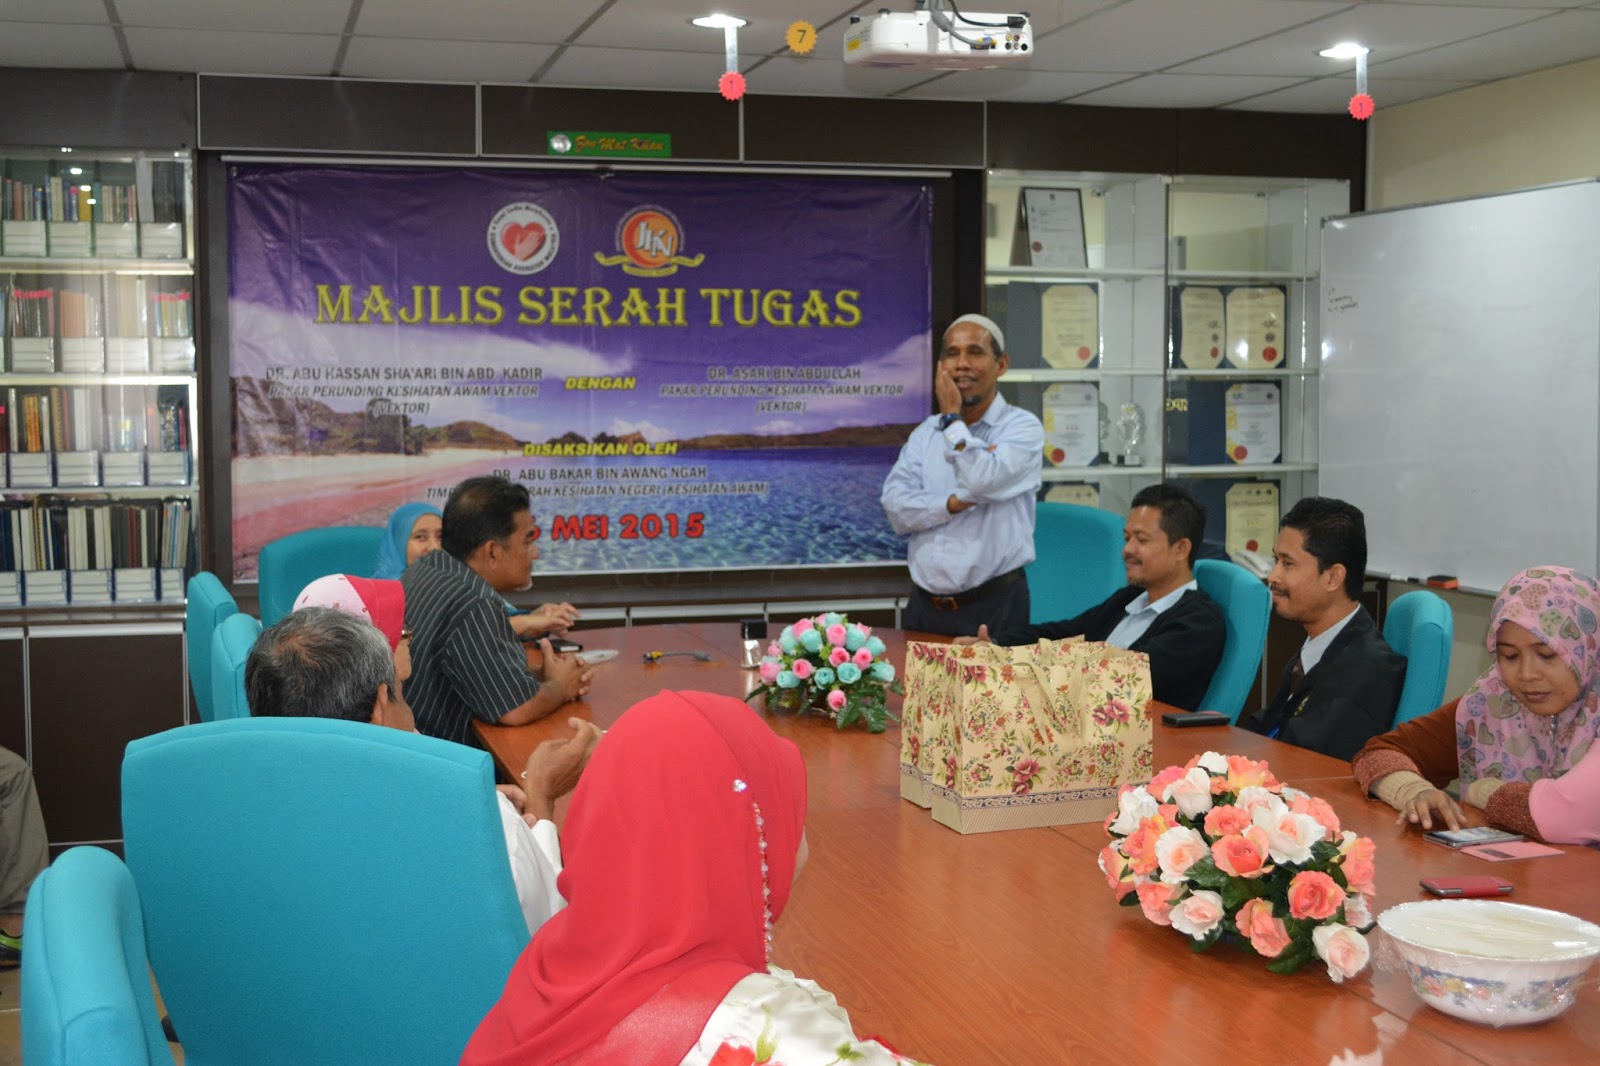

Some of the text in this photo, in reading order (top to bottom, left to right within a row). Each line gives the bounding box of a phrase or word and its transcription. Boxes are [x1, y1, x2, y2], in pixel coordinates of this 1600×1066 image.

[797, 29, 807, 44] 7
[314, 284, 863, 328] MAJLIS SERAH TUGAS
[292, 367, 321, 380] ABU
[384, 367, 437, 380] SHA'ARI
[441, 367, 464, 380] BIN
[502, 367, 543, 380] KADIR
[733, 367, 770, 380] ASARI
[773, 367, 795, 380] BIN
[797, 367, 862, 379] ABDULLAH
[565, 376, 637, 391] DENGAN
[661, 384, 904, 397] PAKAR PERUNDING KESIHATAN AWAM VEKTOR
[312, 385, 383, 398] PERUNDING
[385, 385, 452, 397] KESIHATAN
[454, 385, 491, 397] AWAM
[493, 385, 539, 397] VEKTOR
[373, 402, 430, 416] (VEKTOR)
[755, 401, 807, 416] (VEKTOR)
[523, 442, 679, 457] DISAKSIKAN OLEH
[519, 469, 546, 481] ABU
[550, 468, 593, 480] BAKAR
[597, 468, 619, 479] BIN
[621, 467, 668, 479] AWANG
[671, 466, 707, 478] NGAH
[554, 485, 616, 497] KESIHATAN
[620, 485, 661, 496] NEGERI
[662, 484, 729, 496] (KESIHATAN
[731, 482, 769, 496] AWAM)
[551, 514, 609, 541] MEI
[619, 512, 705, 540] 2015
